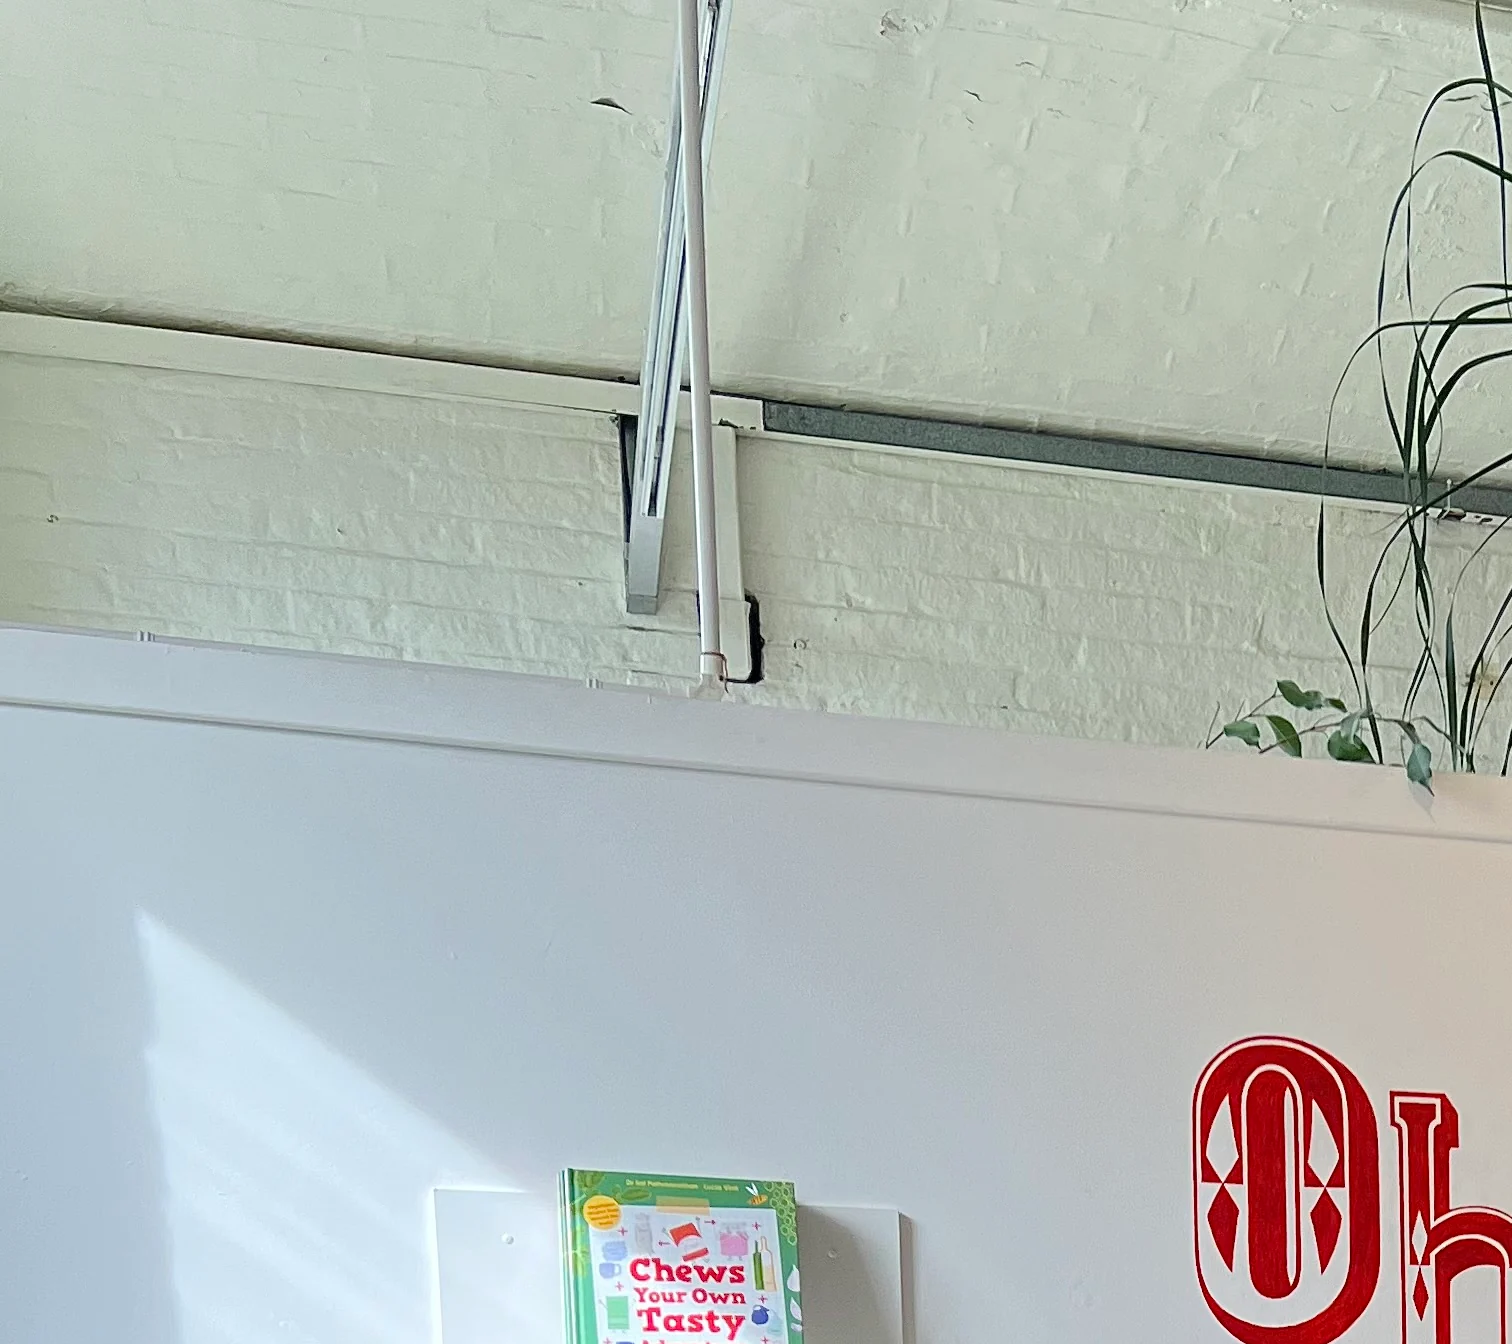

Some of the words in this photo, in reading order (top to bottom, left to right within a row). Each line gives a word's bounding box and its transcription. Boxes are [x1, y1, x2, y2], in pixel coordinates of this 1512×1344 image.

[629, 1258, 746, 1284] Chews
[634, 1288, 686, 1304] Your
[692, 1288, 746, 1304] Own
[637, 1307, 746, 1341] Tasty
